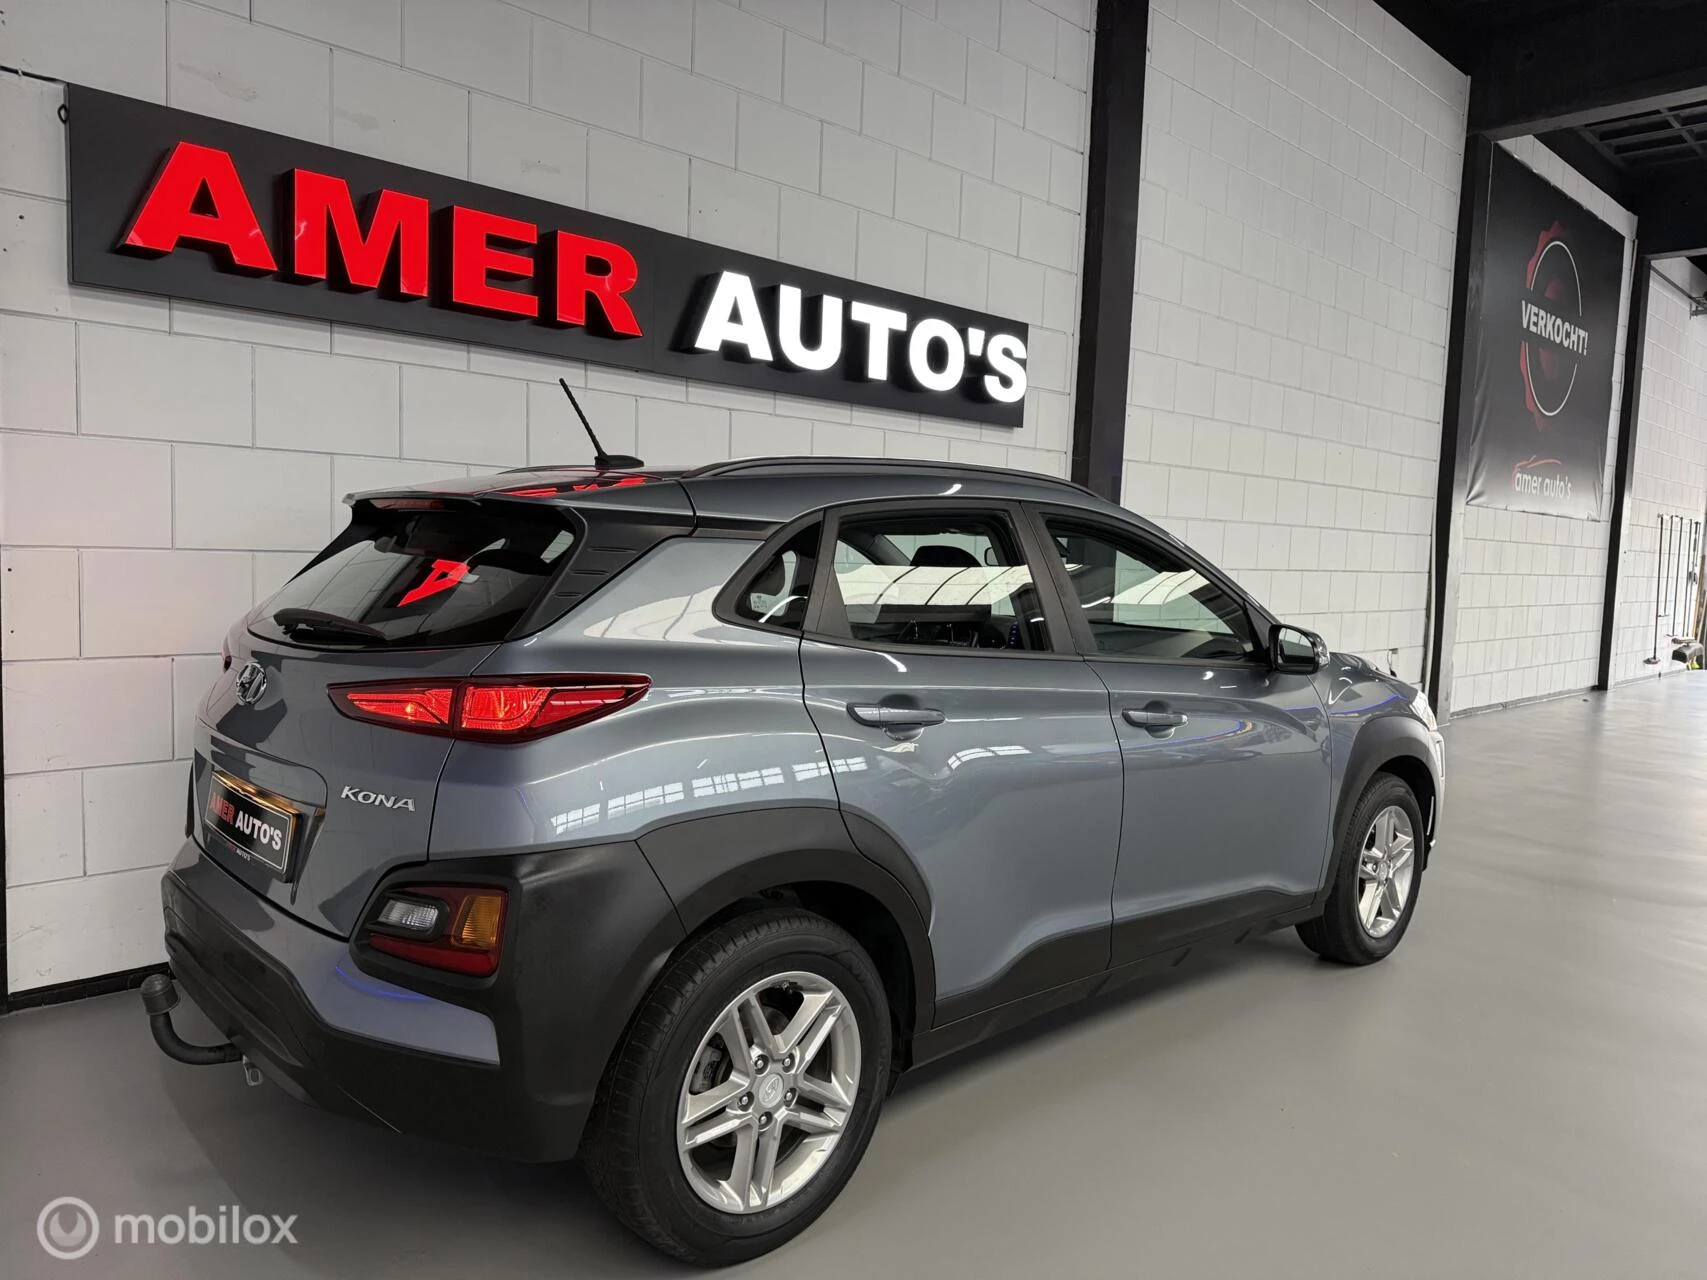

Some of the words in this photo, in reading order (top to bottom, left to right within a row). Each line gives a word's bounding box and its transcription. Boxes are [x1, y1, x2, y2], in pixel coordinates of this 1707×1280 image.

[123, 141, 643, 337] AMER
[694, 270, 1028, 403] AUTO'S
[1521, 300, 1588, 356] VERKOCHT!
[1514, 472, 1542, 495] amer
[1543, 474, 1572, 500] auto's
[209, 792, 235, 825] AMER
[235, 810, 282, 851] AUTO'S
[340, 786, 416, 812] KONA
